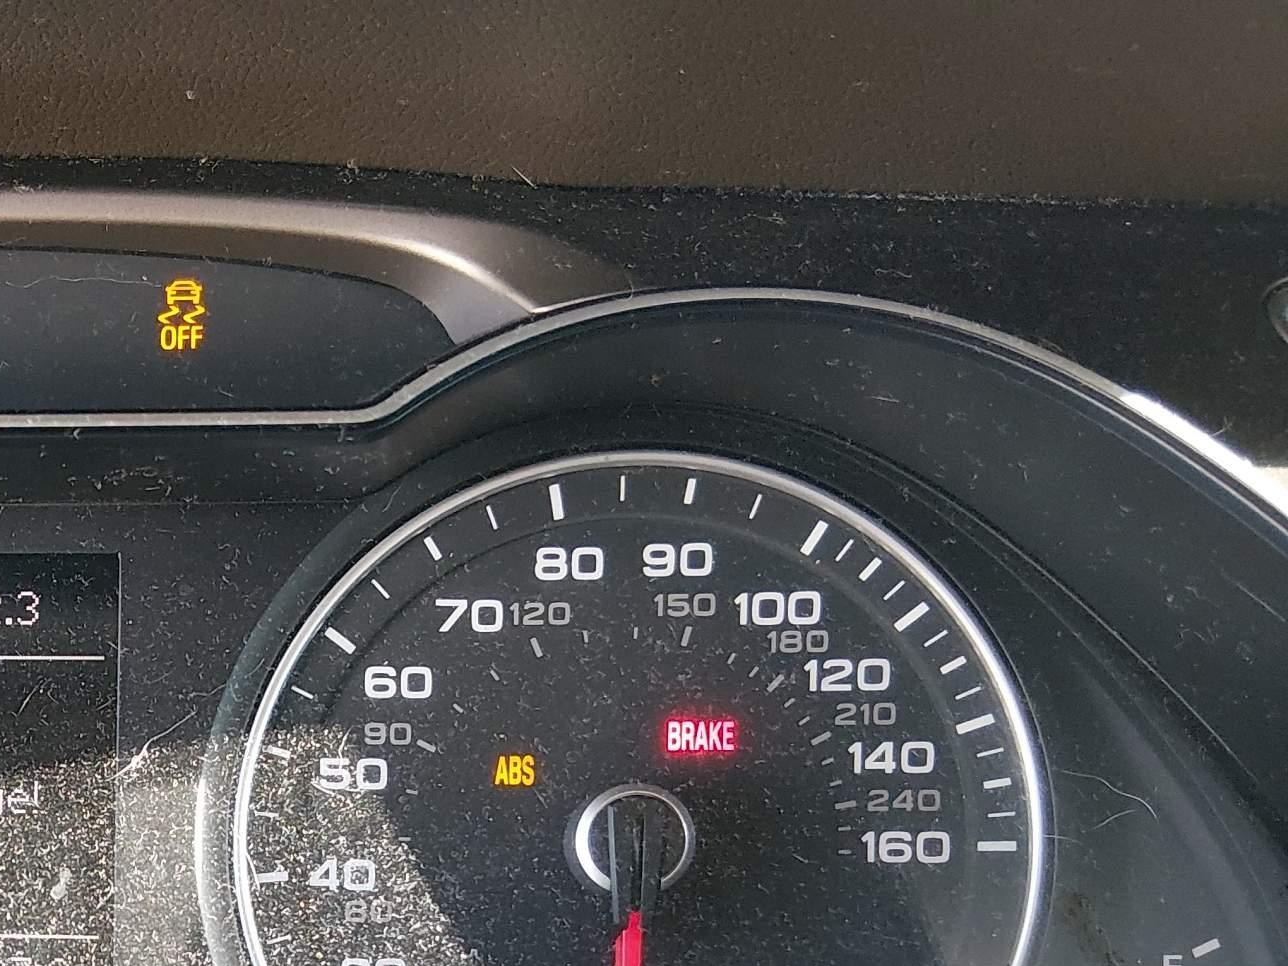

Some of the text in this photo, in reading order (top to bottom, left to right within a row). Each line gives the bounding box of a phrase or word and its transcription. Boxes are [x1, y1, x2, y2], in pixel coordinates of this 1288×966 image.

[160, 324, 204, 351] OFF
[534, 546, 605, 581] 80
[642, 541, 714, 577] 90
[435, 599, 504, 632] 70
[509, 600, 571, 626] 120
[654, 592, 716, 618] 150
[734, 590, 822, 626] 100
[767, 629, 829, 654] 180
[364, 666, 433, 699] 60
[803, 657, 891, 692] 120
[834, 702, 896, 727] 210
[364, 722, 412, 746] 90
[665, 719, 736, 752] BRAKE
[494, 754, 536, 786] ABS
[847, 740, 935, 774] 140
[319, 757, 388, 791] 50
[866, 788, 941, 813] 240
[859, 831, 951, 864] 160
[308, 855, 378, 892] 40
